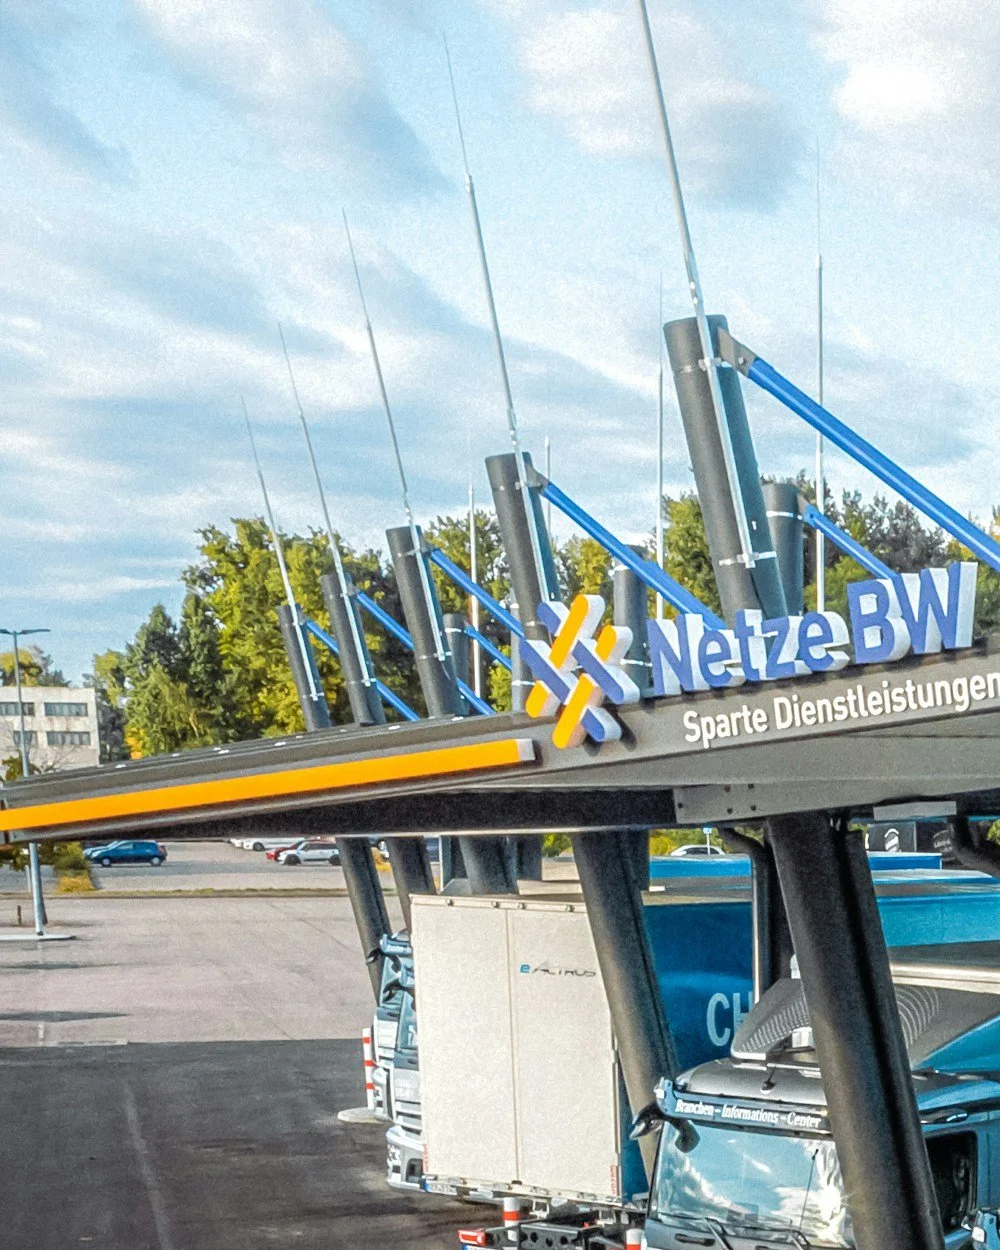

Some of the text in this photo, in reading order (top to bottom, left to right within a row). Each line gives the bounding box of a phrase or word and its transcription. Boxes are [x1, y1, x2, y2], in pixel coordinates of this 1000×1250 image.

[646, 561, 979, 697] Netze BW
[683, 703, 769, 749] Sparte
